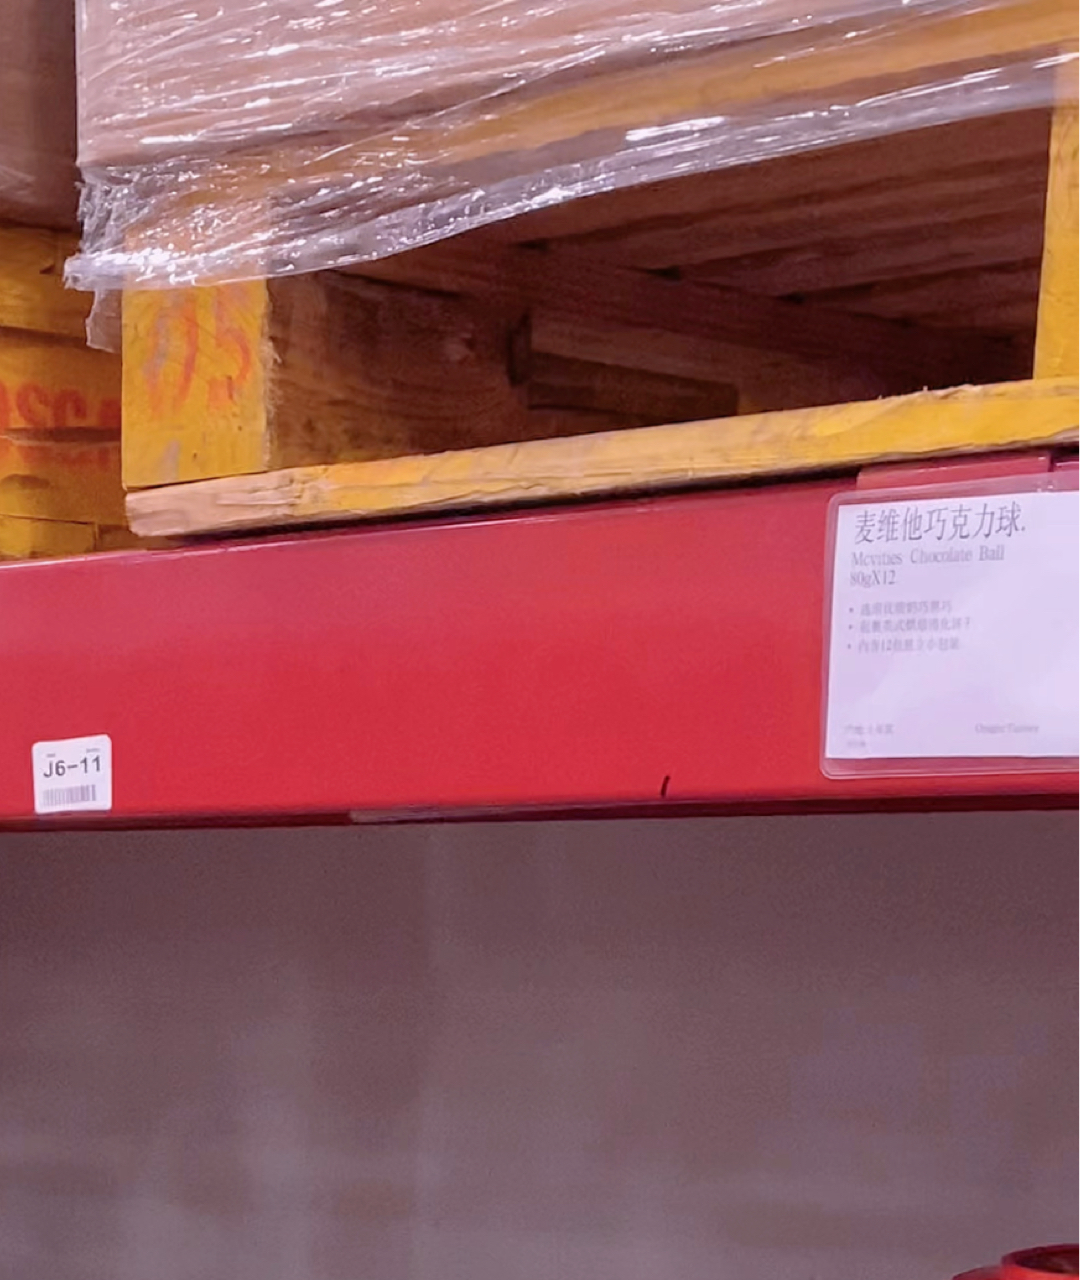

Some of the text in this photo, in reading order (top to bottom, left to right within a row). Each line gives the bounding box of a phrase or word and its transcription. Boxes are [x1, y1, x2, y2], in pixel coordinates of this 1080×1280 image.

[910, 547, 972, 565] Chocolate
[979, 544, 1005, 562] Ball
[43, 755, 100, 778] J6-11
